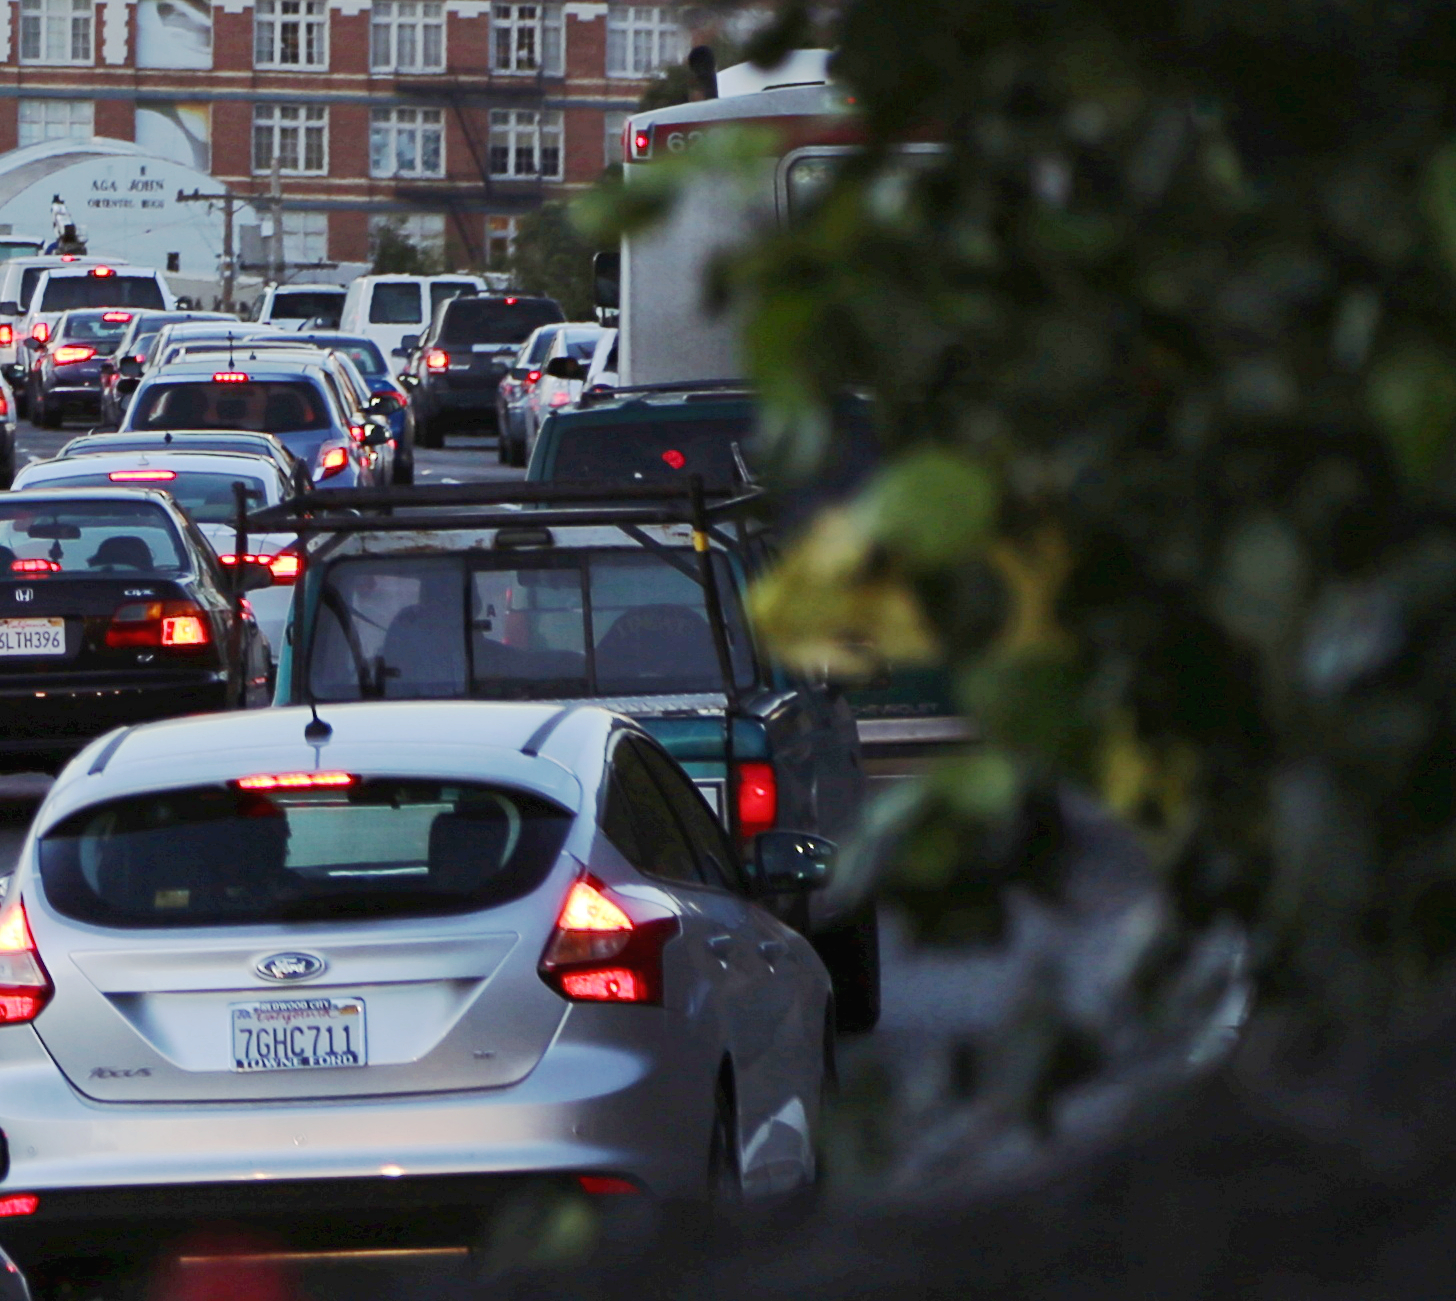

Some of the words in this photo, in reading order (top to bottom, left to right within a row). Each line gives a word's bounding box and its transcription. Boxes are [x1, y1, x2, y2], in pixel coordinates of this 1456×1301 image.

[91, 180, 118, 192] AGA
[127, 180, 164, 192] JOHN
[239, 1024, 358, 1060] 7GHC711
[239, 1056, 302, 1069] TOWNE
[308, 1053, 355, 1067] FORD
